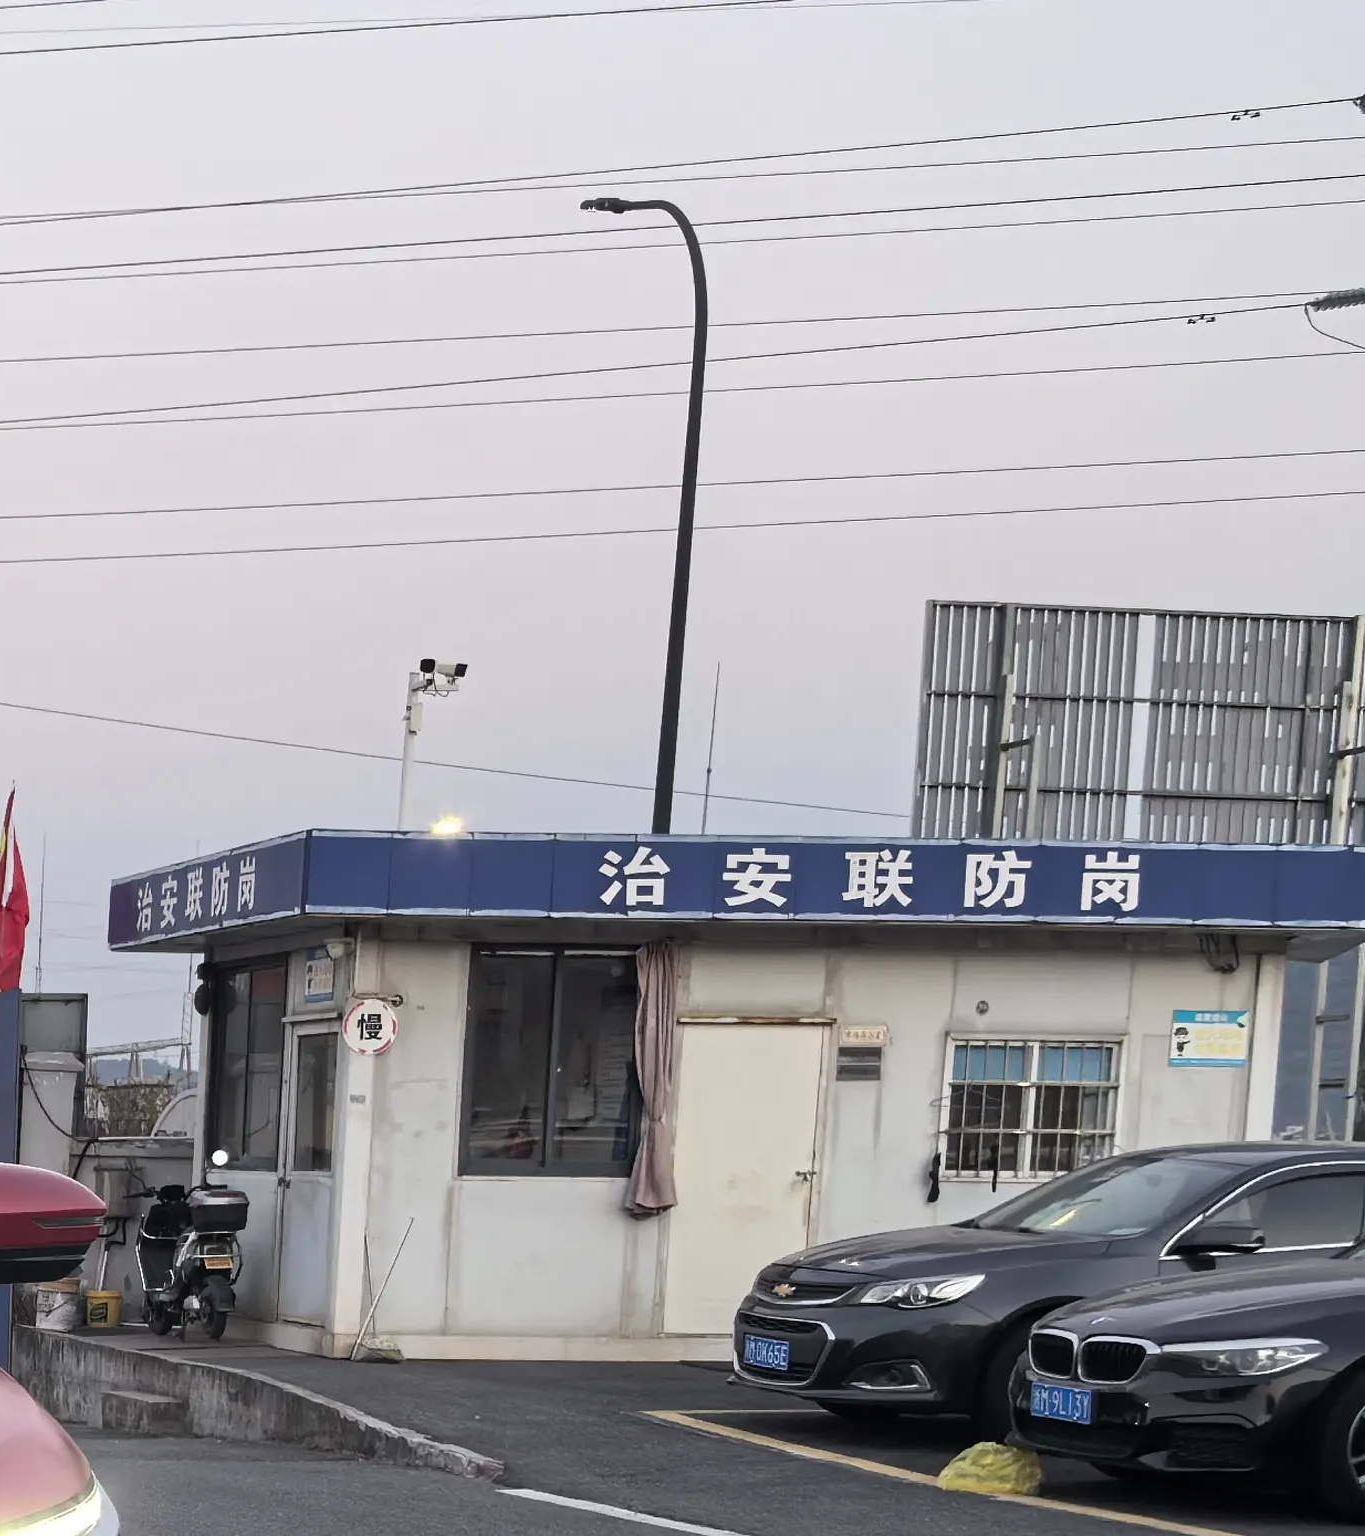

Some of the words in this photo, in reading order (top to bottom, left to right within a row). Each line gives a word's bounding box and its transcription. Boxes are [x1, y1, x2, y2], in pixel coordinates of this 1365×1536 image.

[136, 855, 256, 932] 治安联防岗
[598, 846, 1141, 912] 治安联防岗
[356, 1013, 383, 1041] 慢
